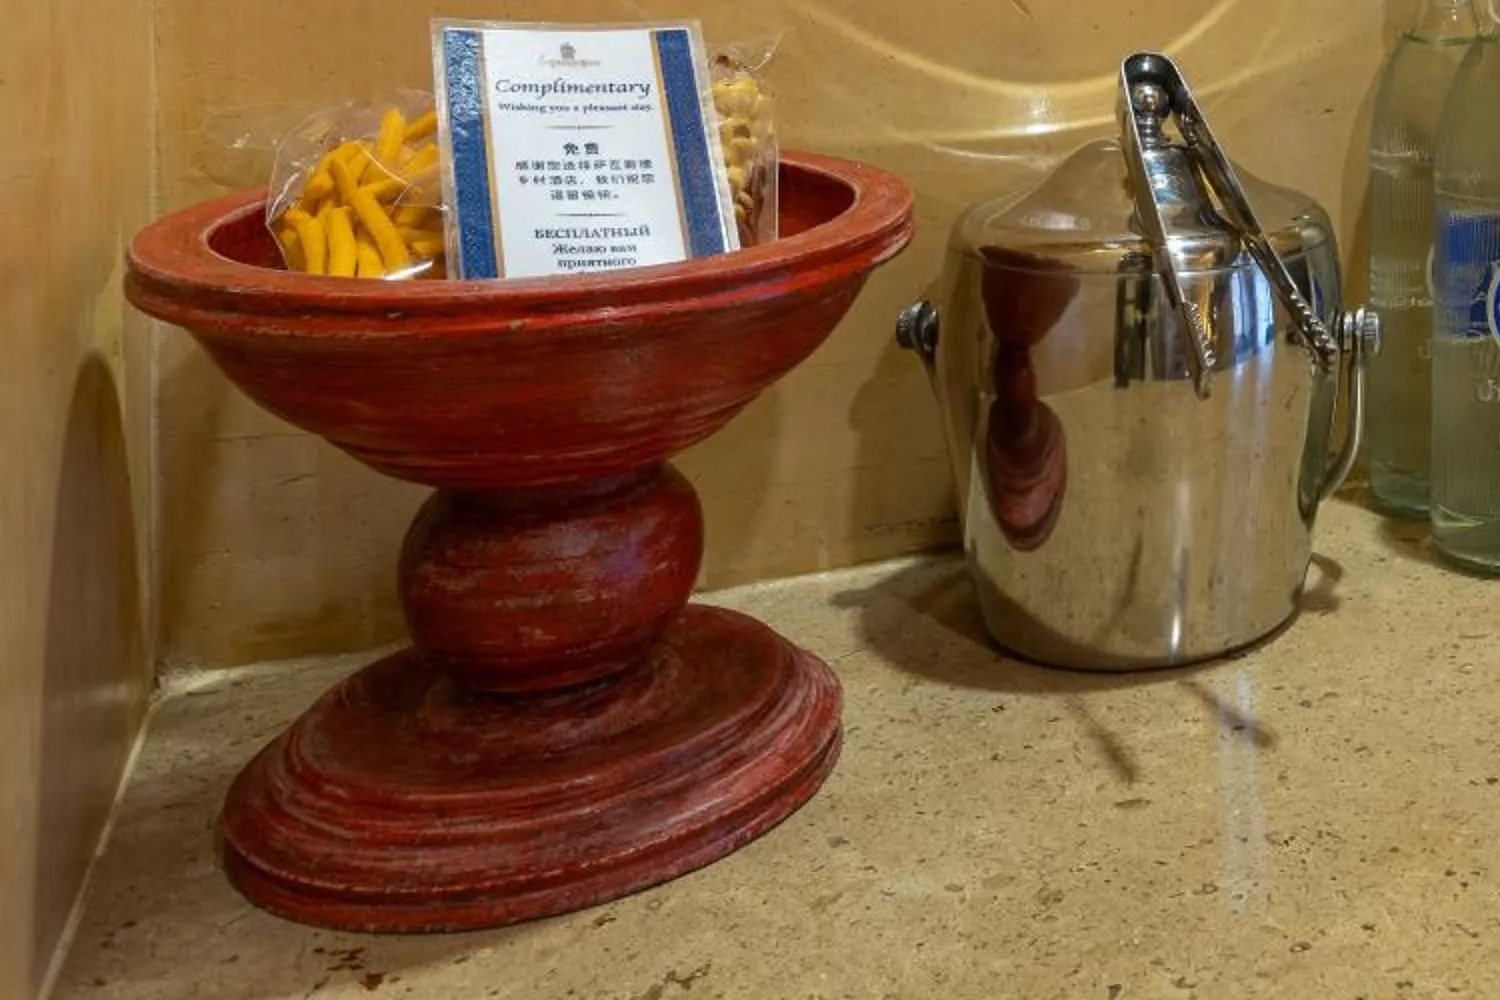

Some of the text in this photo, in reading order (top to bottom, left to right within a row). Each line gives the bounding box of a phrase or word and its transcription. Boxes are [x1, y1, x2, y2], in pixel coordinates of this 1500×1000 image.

[495, 78, 651, 100] Complimentary
[499, 102, 547, 114] Wishing
[549, 105, 571, 114] you
[583, 103, 628, 115] pleasant
[534, 225, 651, 239] БЕСПЛАТНЫЙ
[552, 243, 637, 255] Желаю вам
[558, 257, 637, 270] приятного
